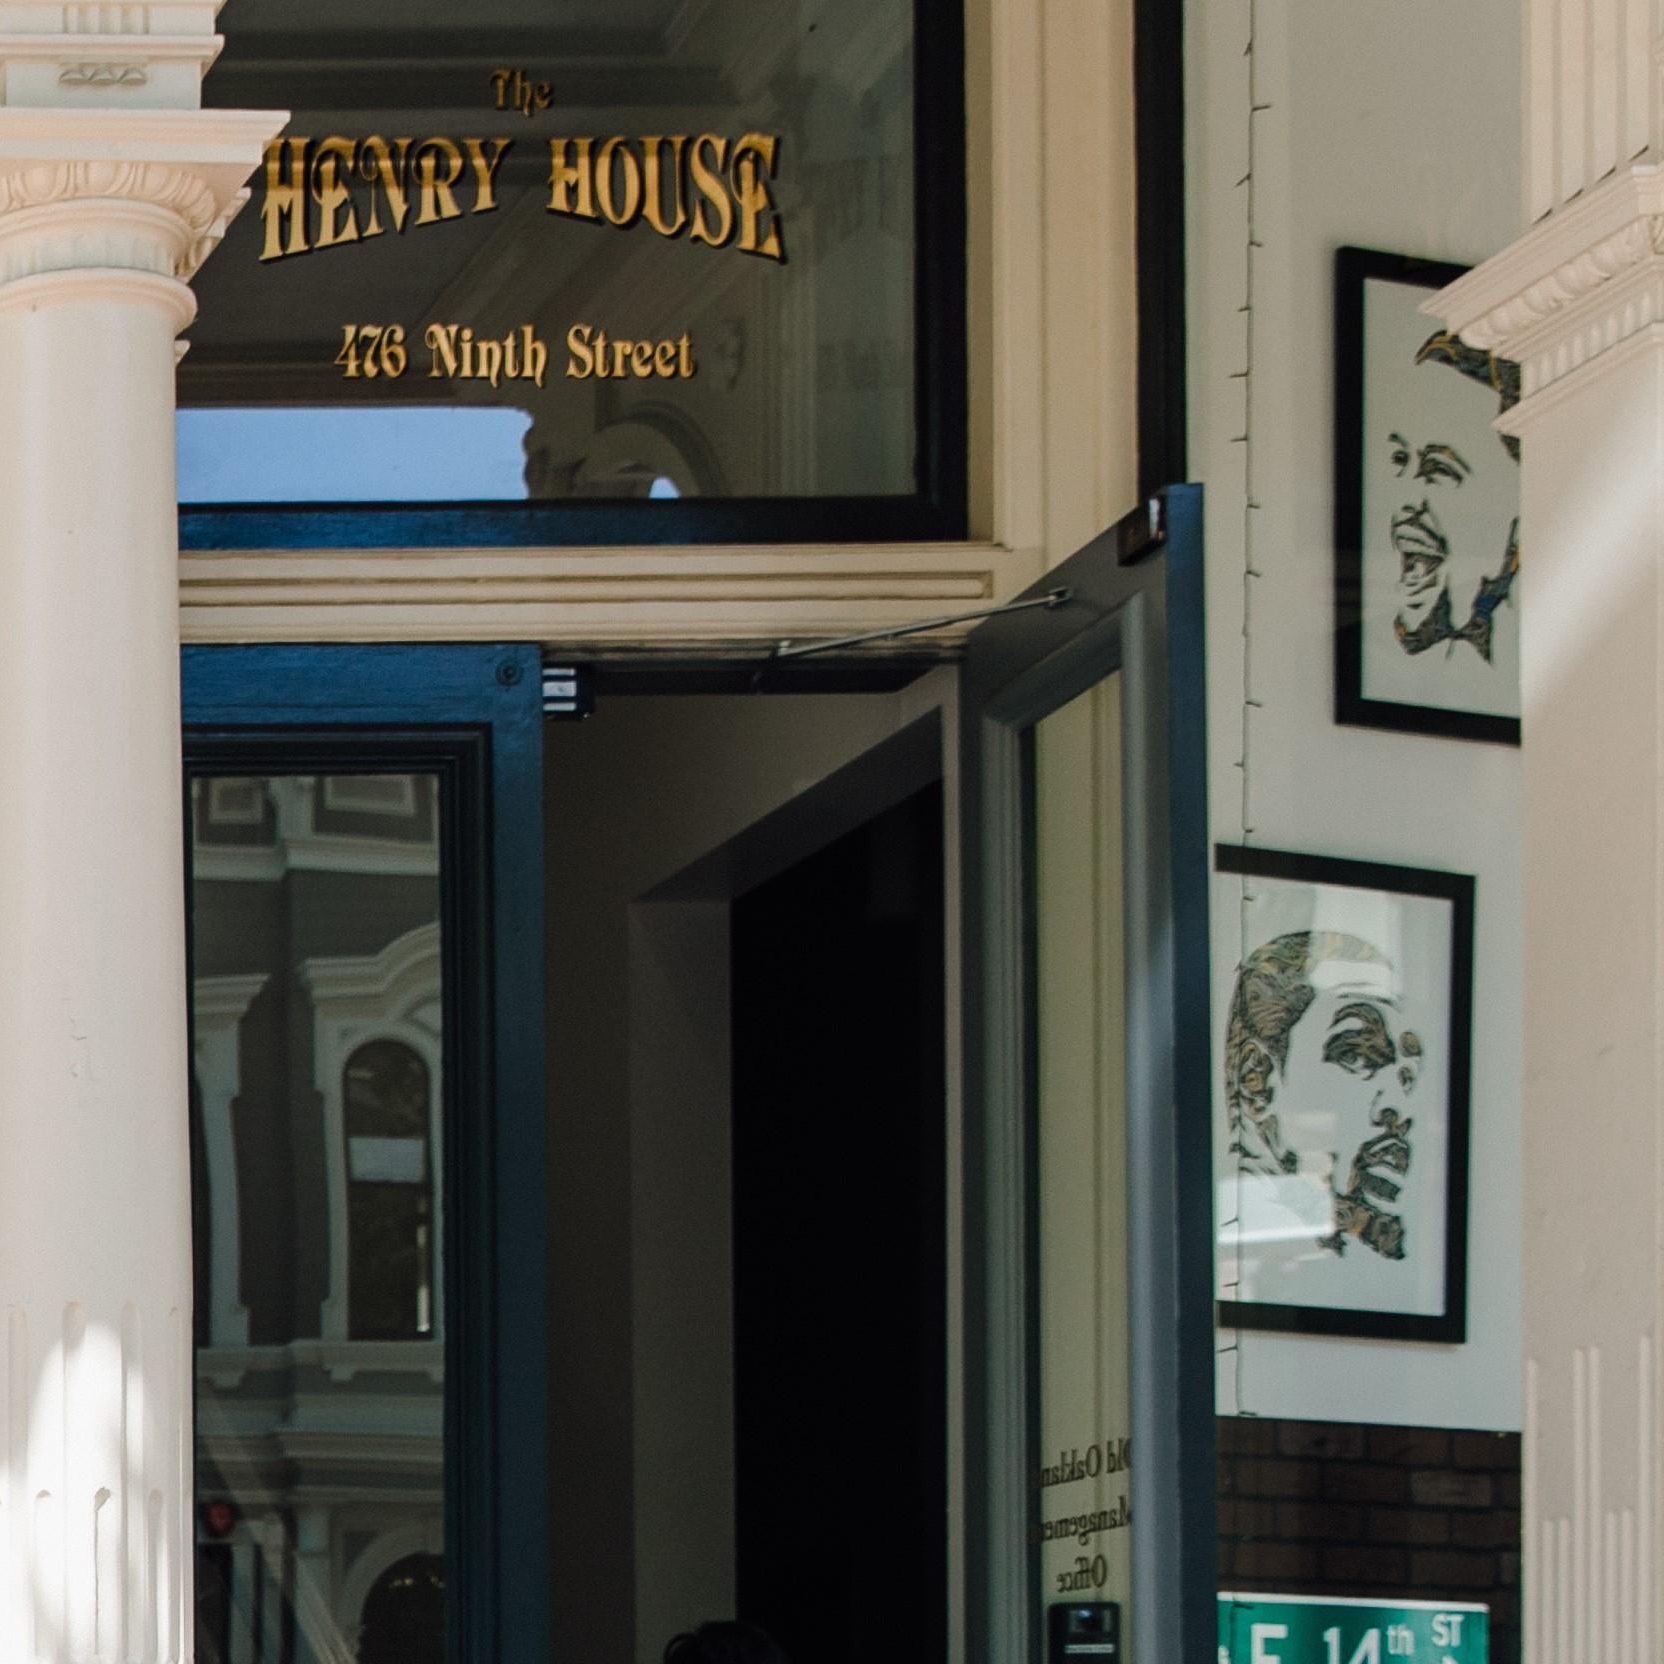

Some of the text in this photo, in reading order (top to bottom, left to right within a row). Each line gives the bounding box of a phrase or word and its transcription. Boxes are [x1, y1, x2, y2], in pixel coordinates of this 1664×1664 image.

[489, 68, 554, 116] The
[258, 132, 787, 265] HENRY HOUSE
[333, 322, 697, 388] 476 Ninth Street
[1430, 1613, 1465, 1648] ST
